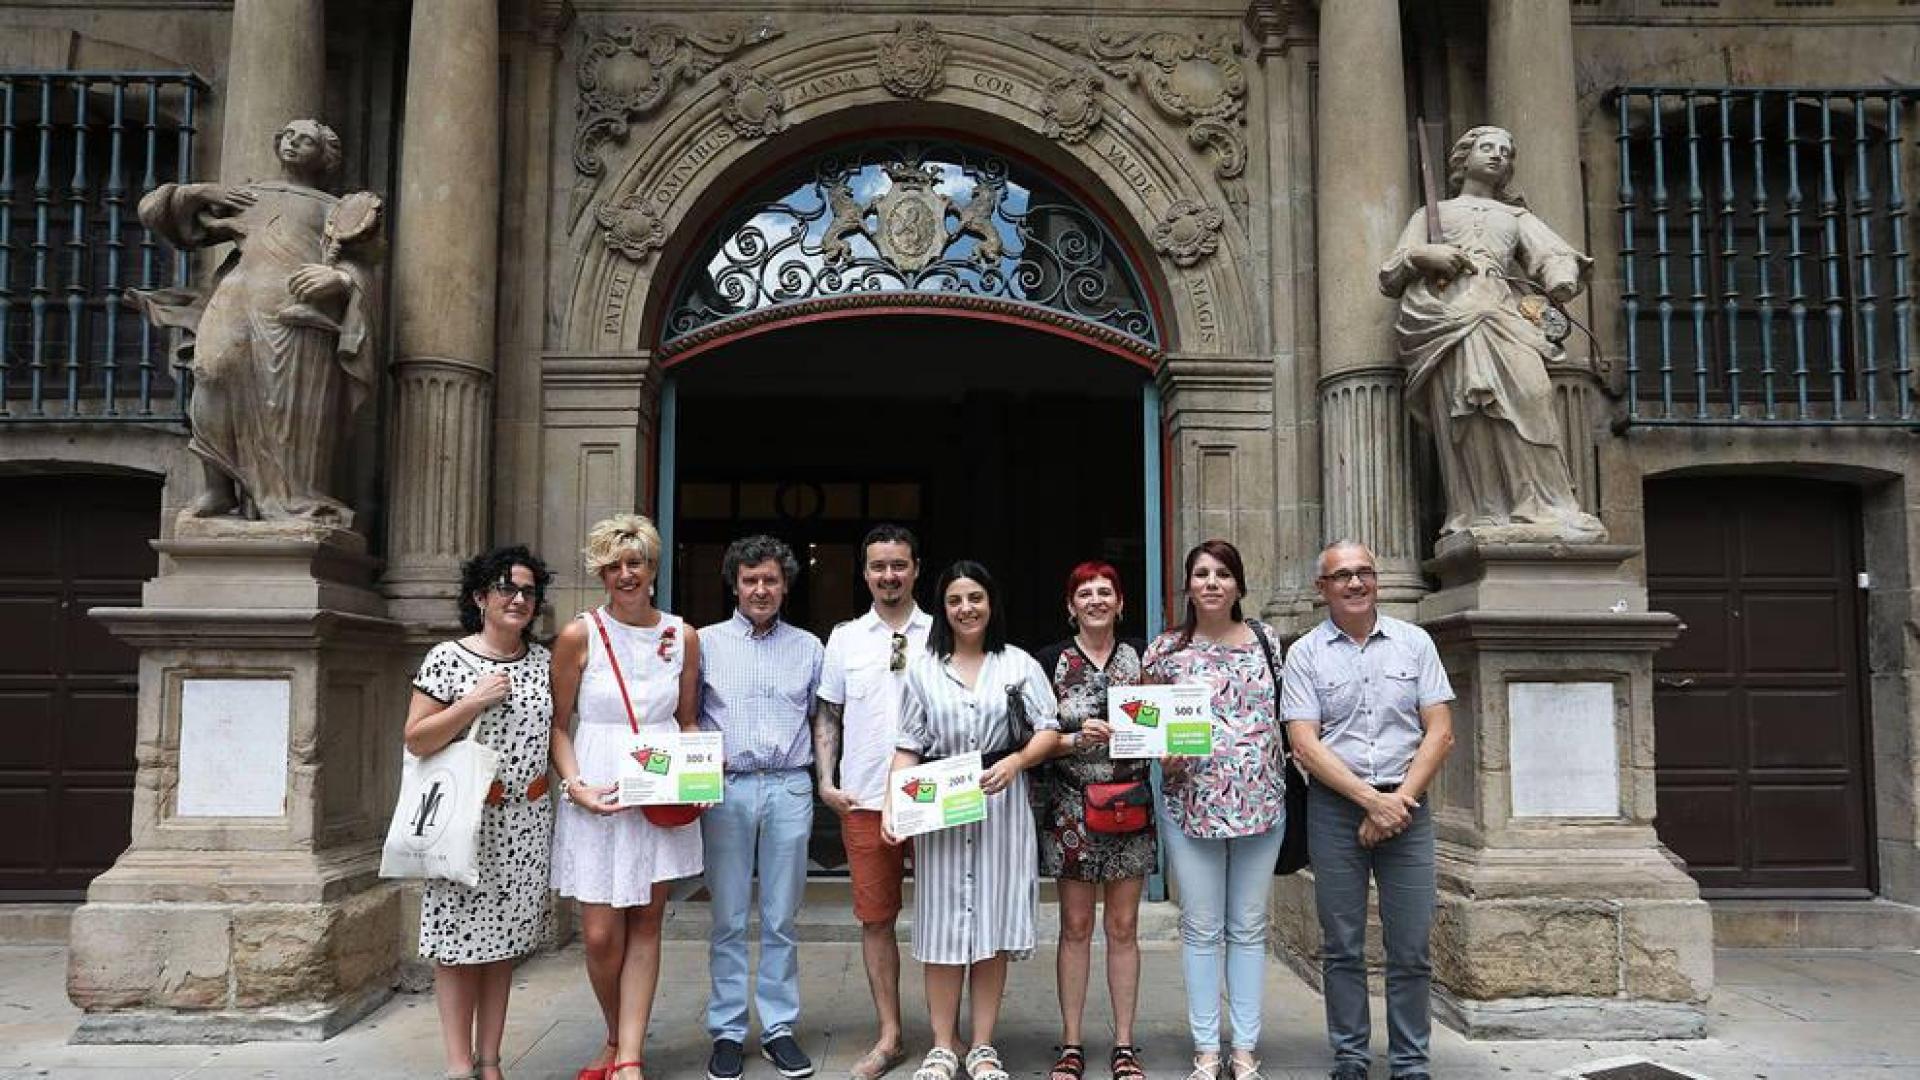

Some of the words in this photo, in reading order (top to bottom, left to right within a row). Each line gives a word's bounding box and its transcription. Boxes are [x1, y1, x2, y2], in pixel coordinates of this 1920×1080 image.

[604, 274, 628, 335] PATET
[656, 127, 731, 203] OMNIBUS
[973, 73, 1014, 98] COR
[1108, 144, 1157, 199] VALDE
[1187, 277, 1217, 344] MAGIS
[1174, 705, 1193, 717] 500
